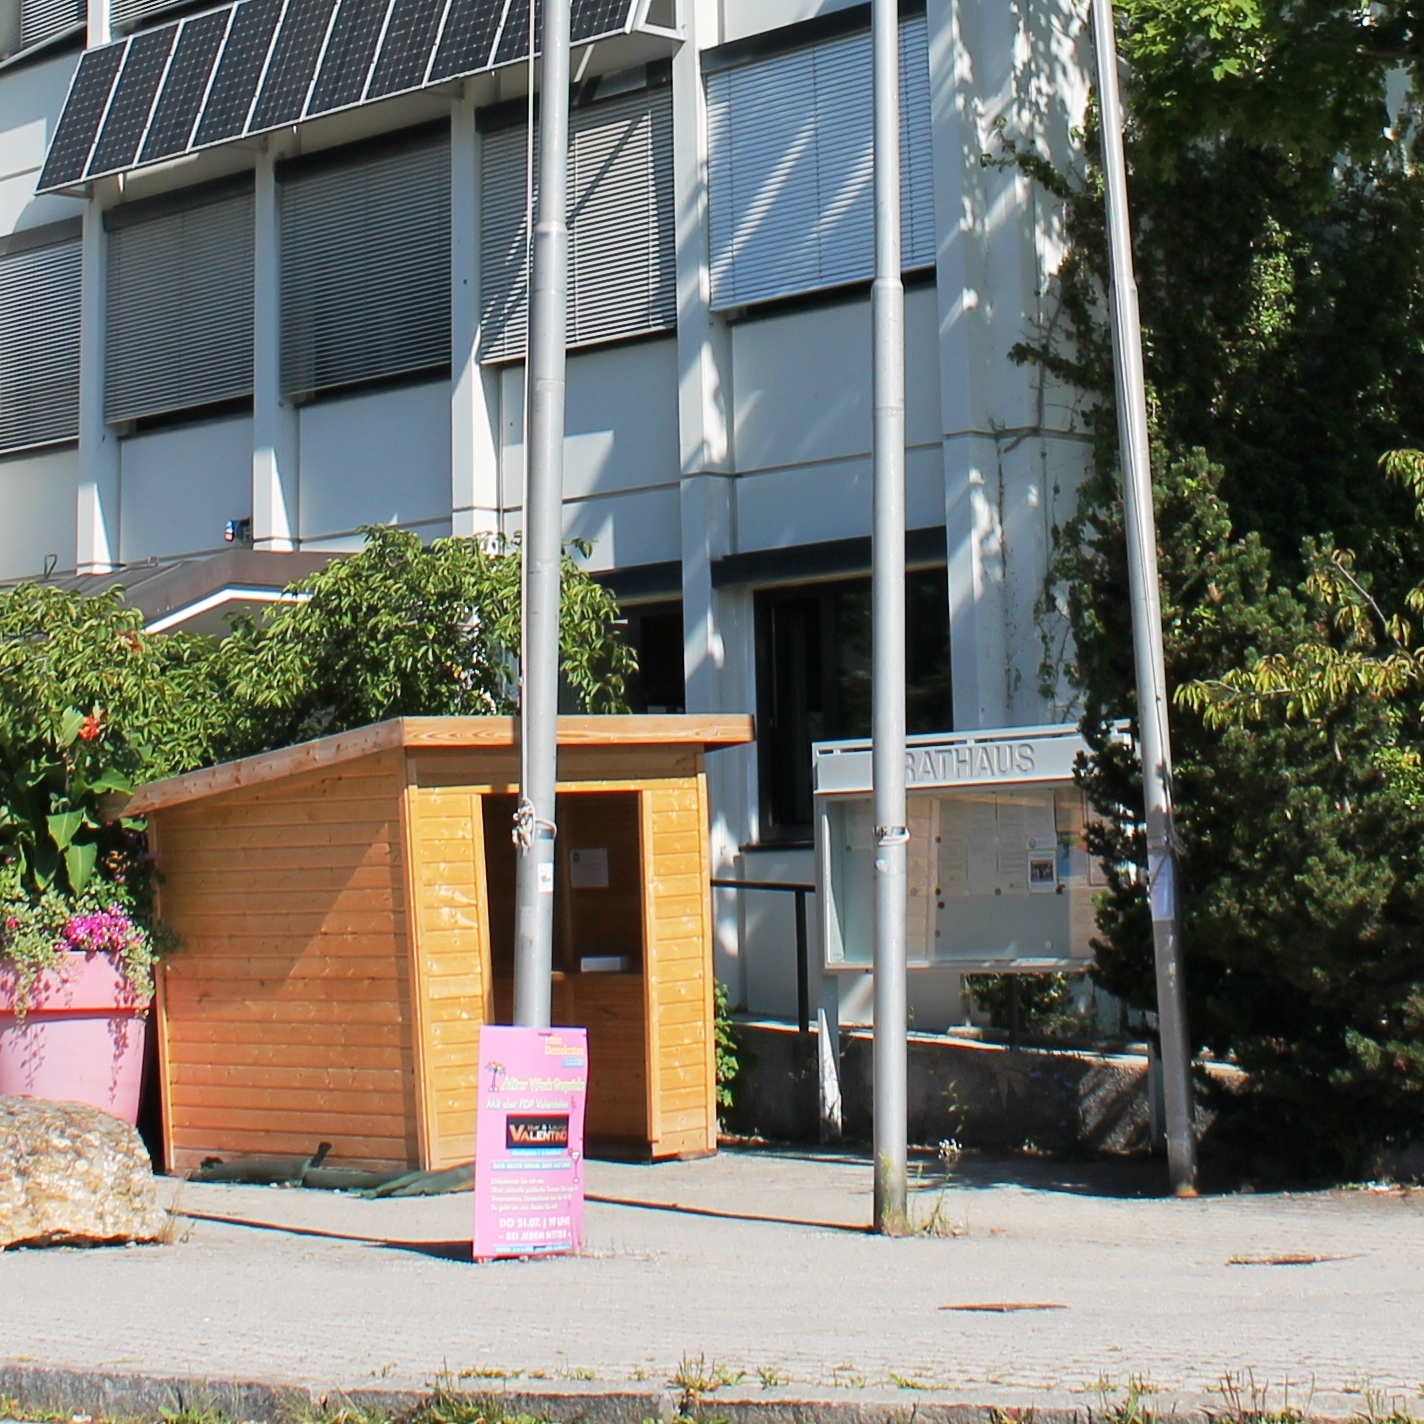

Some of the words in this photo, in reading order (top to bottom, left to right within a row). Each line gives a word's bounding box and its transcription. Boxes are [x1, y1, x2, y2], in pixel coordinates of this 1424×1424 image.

[905, 743, 1035, 782] RATHAUS
[509, 1124, 568, 1142] VALENTINO
[499, 1217, 514, 1228] DO
[521, 1231, 545, 1241] JEDEM
